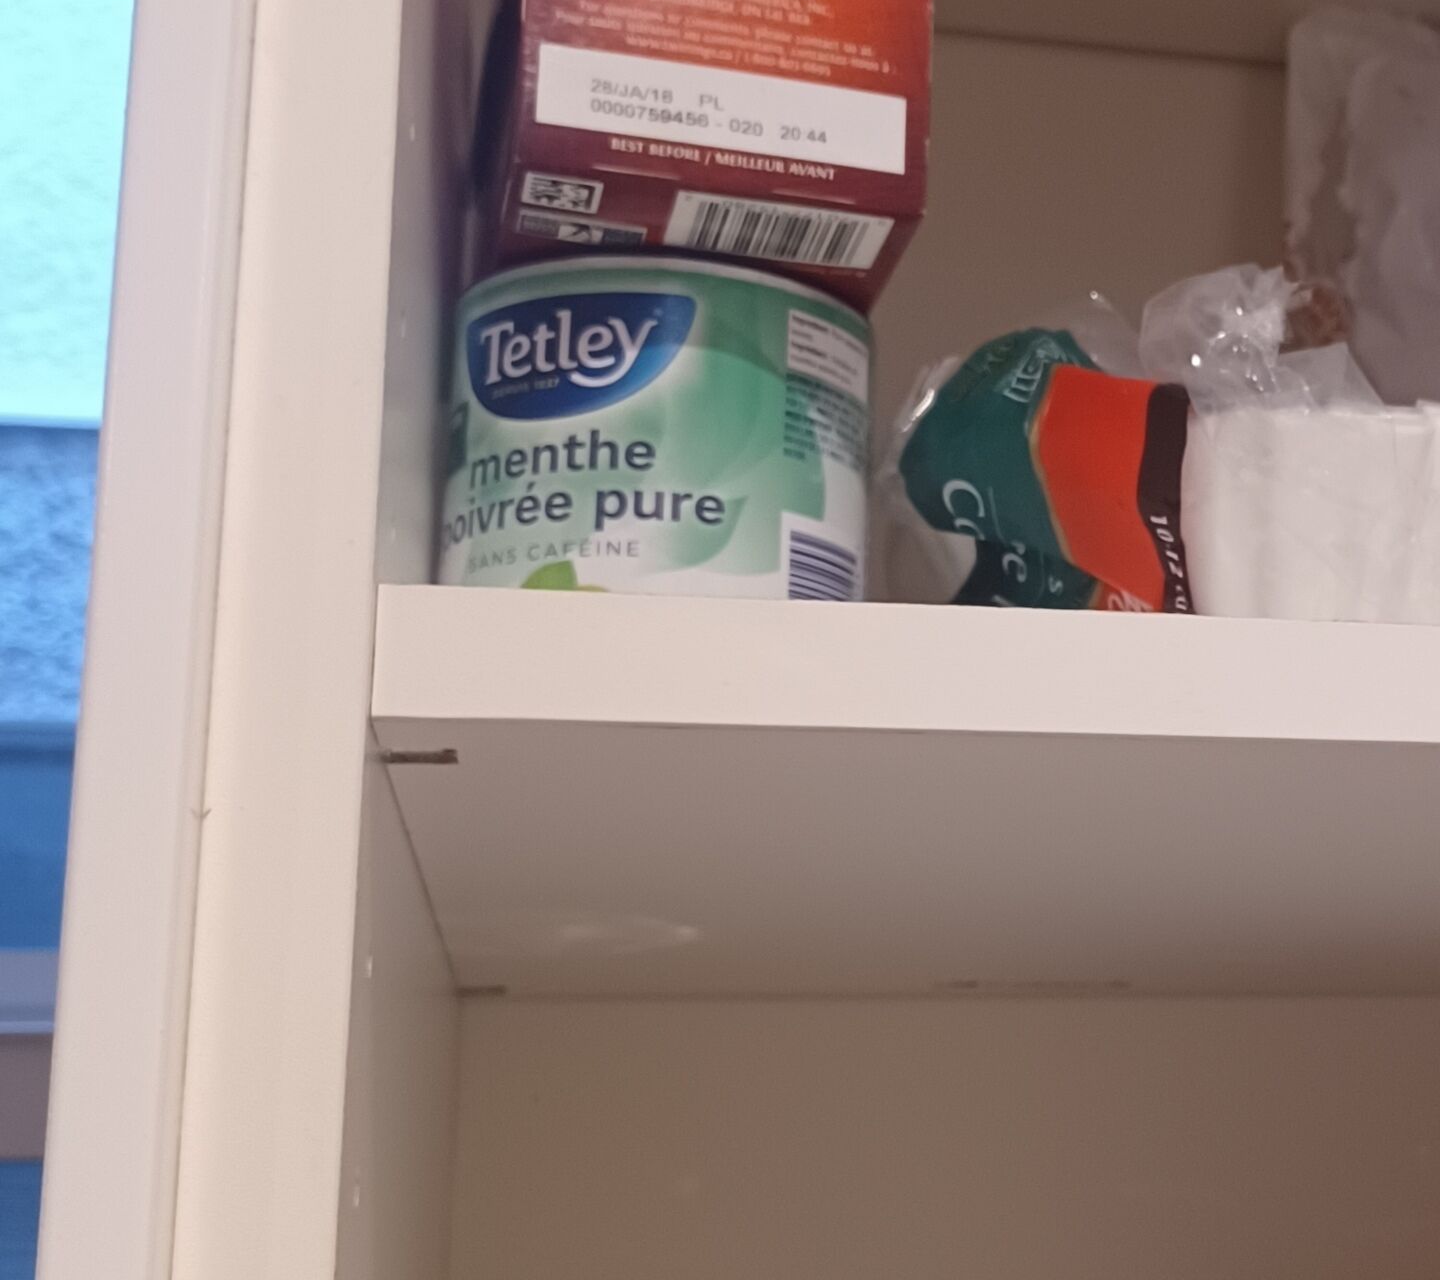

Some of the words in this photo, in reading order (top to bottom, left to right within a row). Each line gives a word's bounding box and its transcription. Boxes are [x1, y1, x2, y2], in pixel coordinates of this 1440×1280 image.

[699, 93, 724, 111] PL
[729, 118, 763, 137] 020
[611, 137, 643, 154] BEST
[649, 141, 700, 162] BEFORE
[715, 151, 785, 174] MEILLEUR
[788, 161, 835, 181] AVANT
[481, 308, 658, 387] Tetley
[470, 429, 656, 489] menthe
[594, 488, 726, 533] pure
[467, 547, 518, 574] SANS
[526, 537, 641, 563] CAFÉINE
